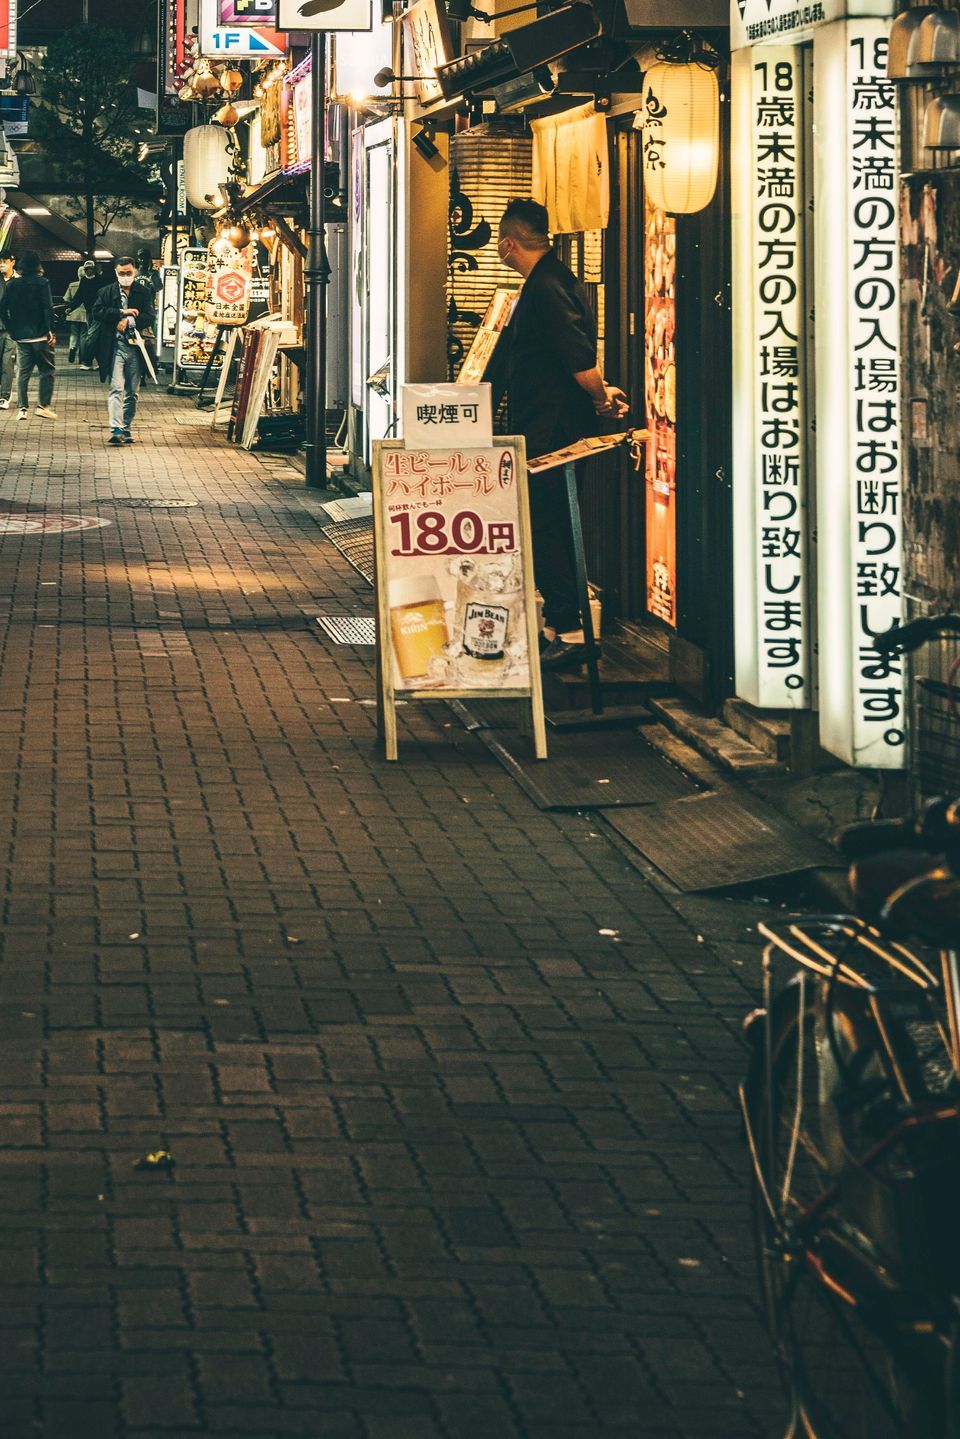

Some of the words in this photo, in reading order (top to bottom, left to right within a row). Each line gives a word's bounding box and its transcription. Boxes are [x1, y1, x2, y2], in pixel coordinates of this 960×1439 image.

[212, 32, 241, 50] 1F
[753, 61, 805, 691] 18歳未満の方の入場はお断り致します。
[415, 403, 480, 425] 喫煙可
[386, 475, 496, 497] ハイボール
